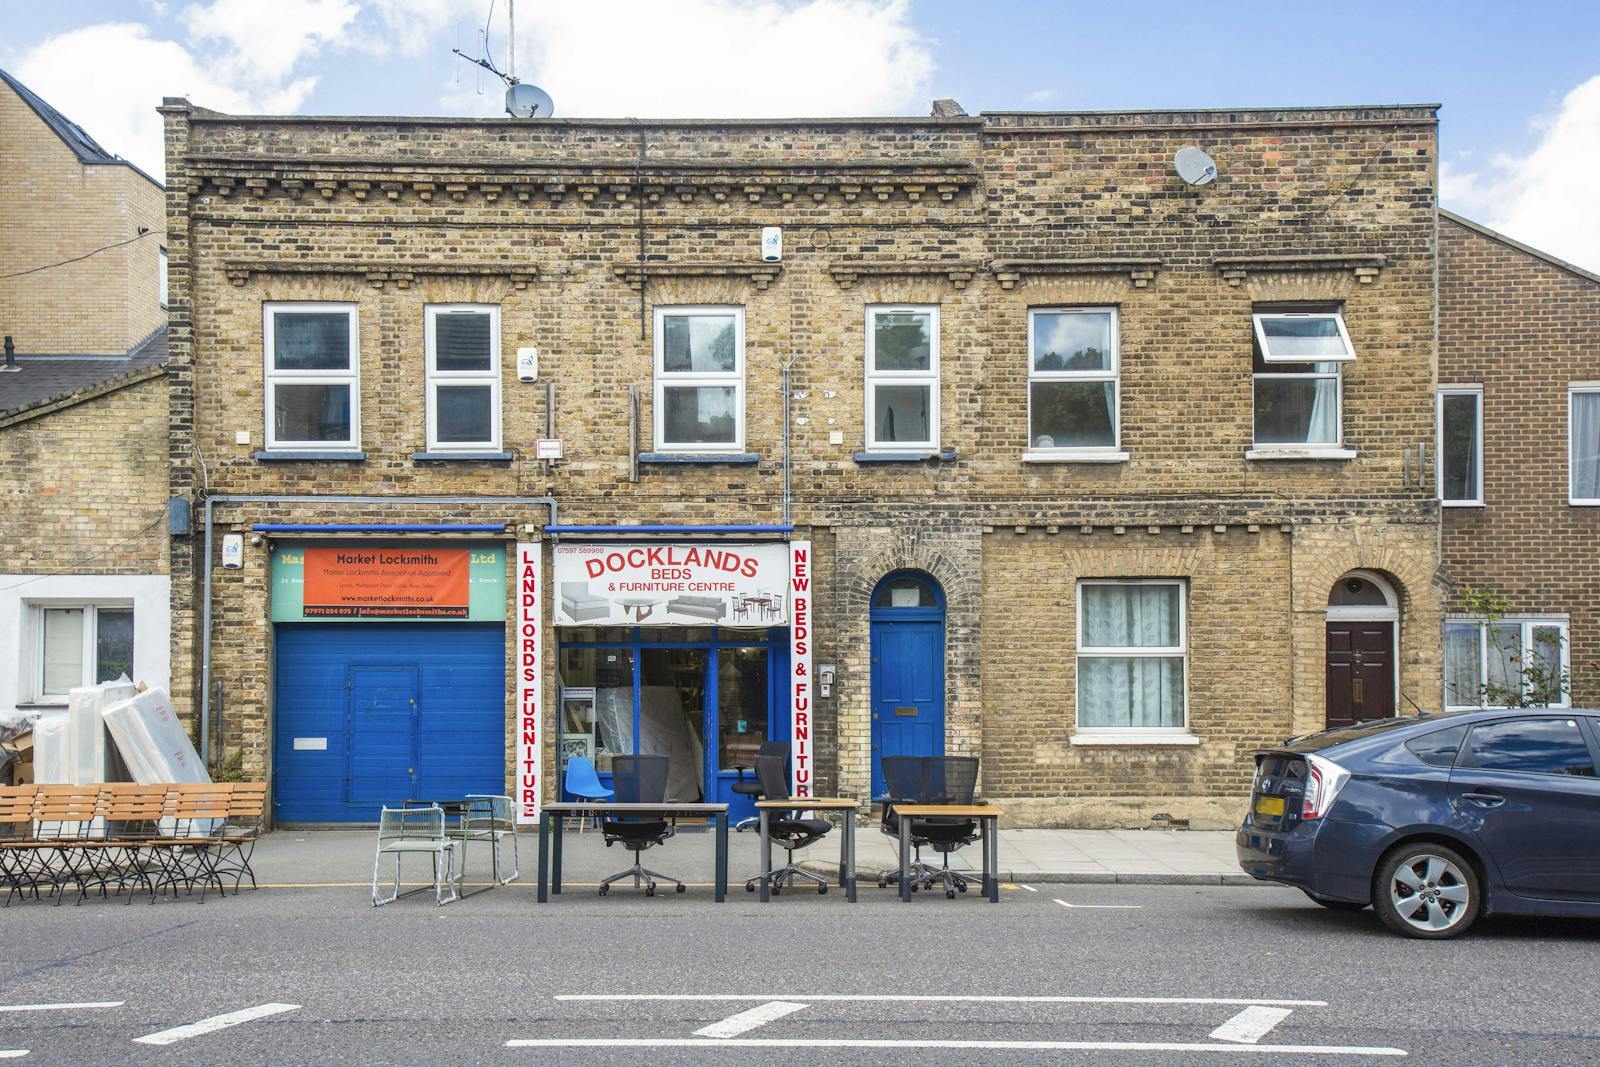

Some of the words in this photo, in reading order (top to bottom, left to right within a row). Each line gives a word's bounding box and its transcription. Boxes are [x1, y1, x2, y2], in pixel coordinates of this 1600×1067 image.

[336, 553, 376, 565] Market
[379, 554, 438, 565] Locksmiths
[470, 553, 496, 564] Ltd
[585, 546, 759, 578] DOCKLANDS
[346, 569, 379, 577] Locksmiths
[380, 569, 416, 577] Association
[418, 569, 451, 577] Approved
[651, 569, 692, 580] BEDS
[792, 549, 809, 592] NEW
[608, 583, 616, 592] &
[619, 582, 685, 592] FURNITURE
[688, 582, 736, 592] CENTRE
[341, 594, 434, 602] www.marketlocksmiths.co.uk
[522, 551, 535, 682] LANDLORDS
[795, 598, 807, 655] BEDS
[795, 662, 807, 676] &
[795, 683, 808, 799] FURNITUR
[523, 688, 535, 817] FURNITURE
